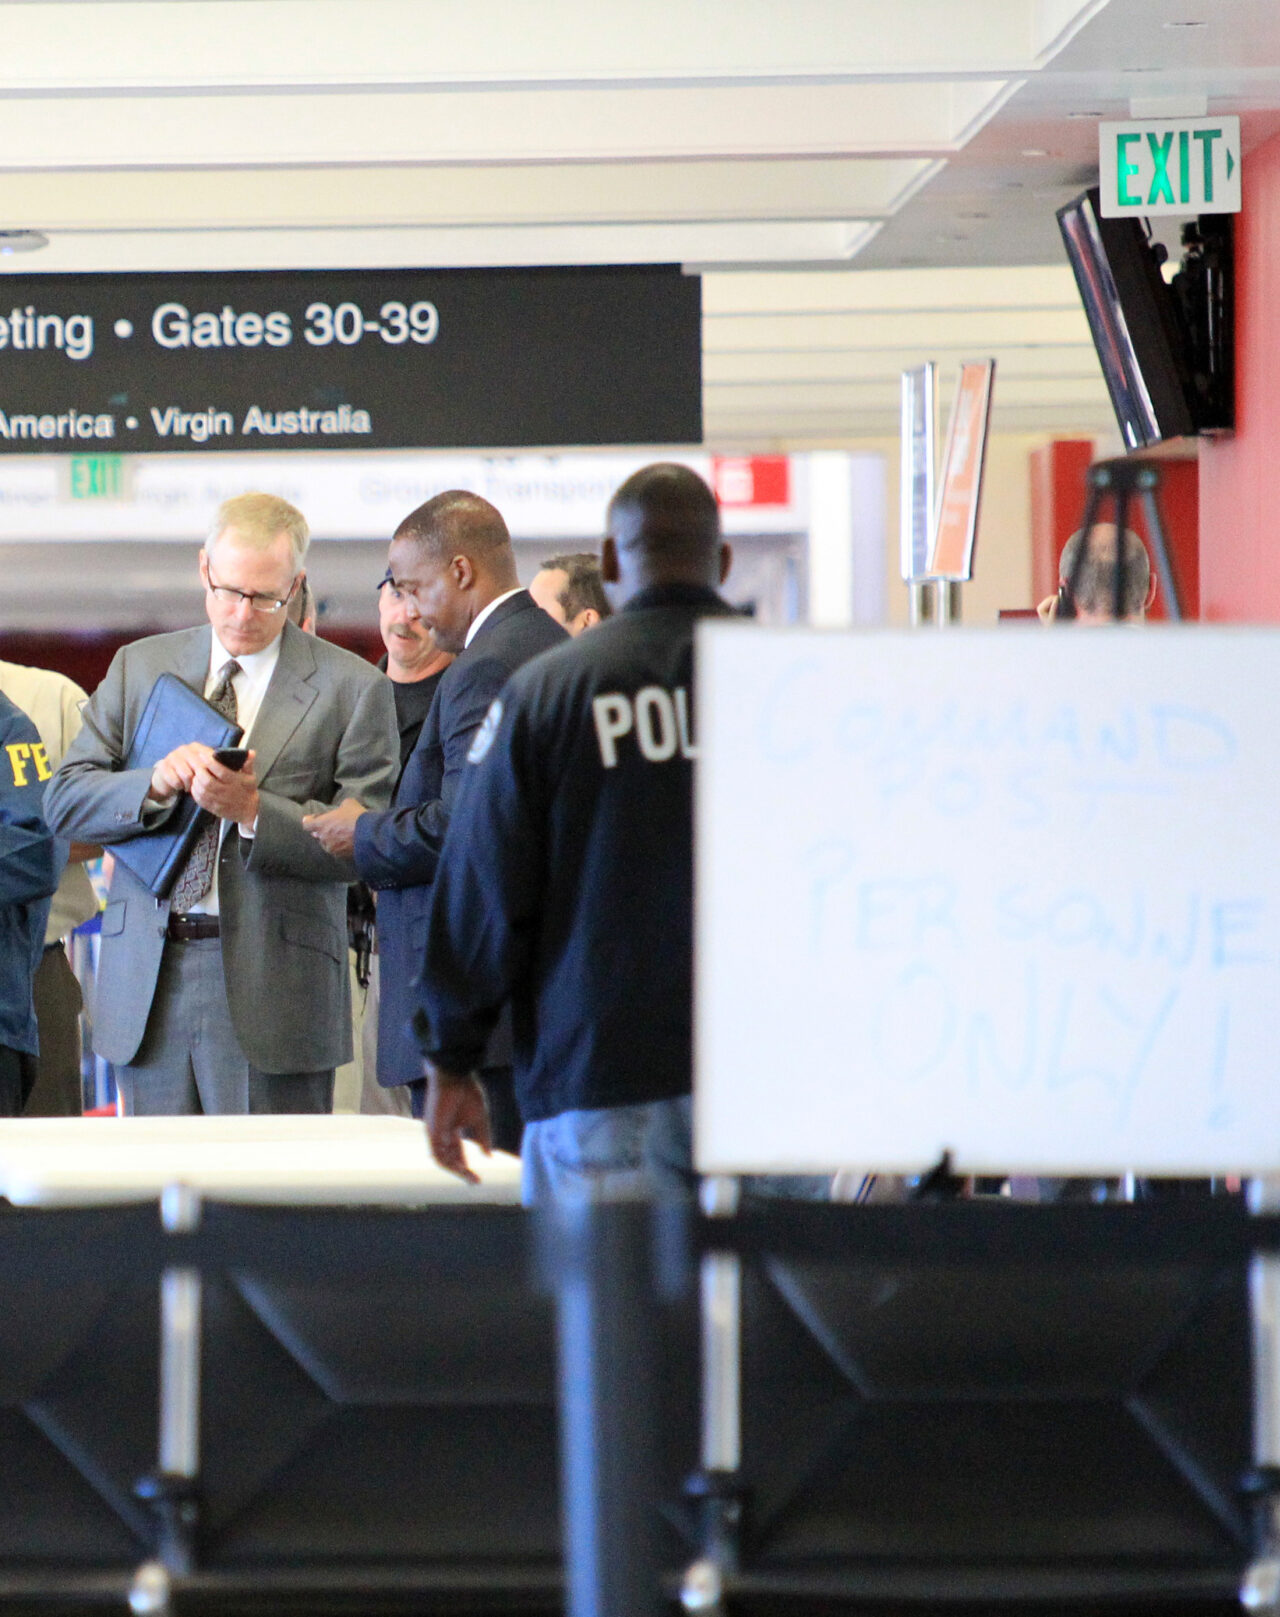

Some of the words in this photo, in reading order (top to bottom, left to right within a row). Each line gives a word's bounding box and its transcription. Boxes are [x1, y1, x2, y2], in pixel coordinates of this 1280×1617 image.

[1116, 128, 1222, 207] EXIT
[151, 303, 292, 349] Gates
[304, 301, 440, 347] 30-39
[150, 407, 234, 444] Virgin
[241, 404, 372, 435] Australia
[71, 454, 122, 500] EXIT
